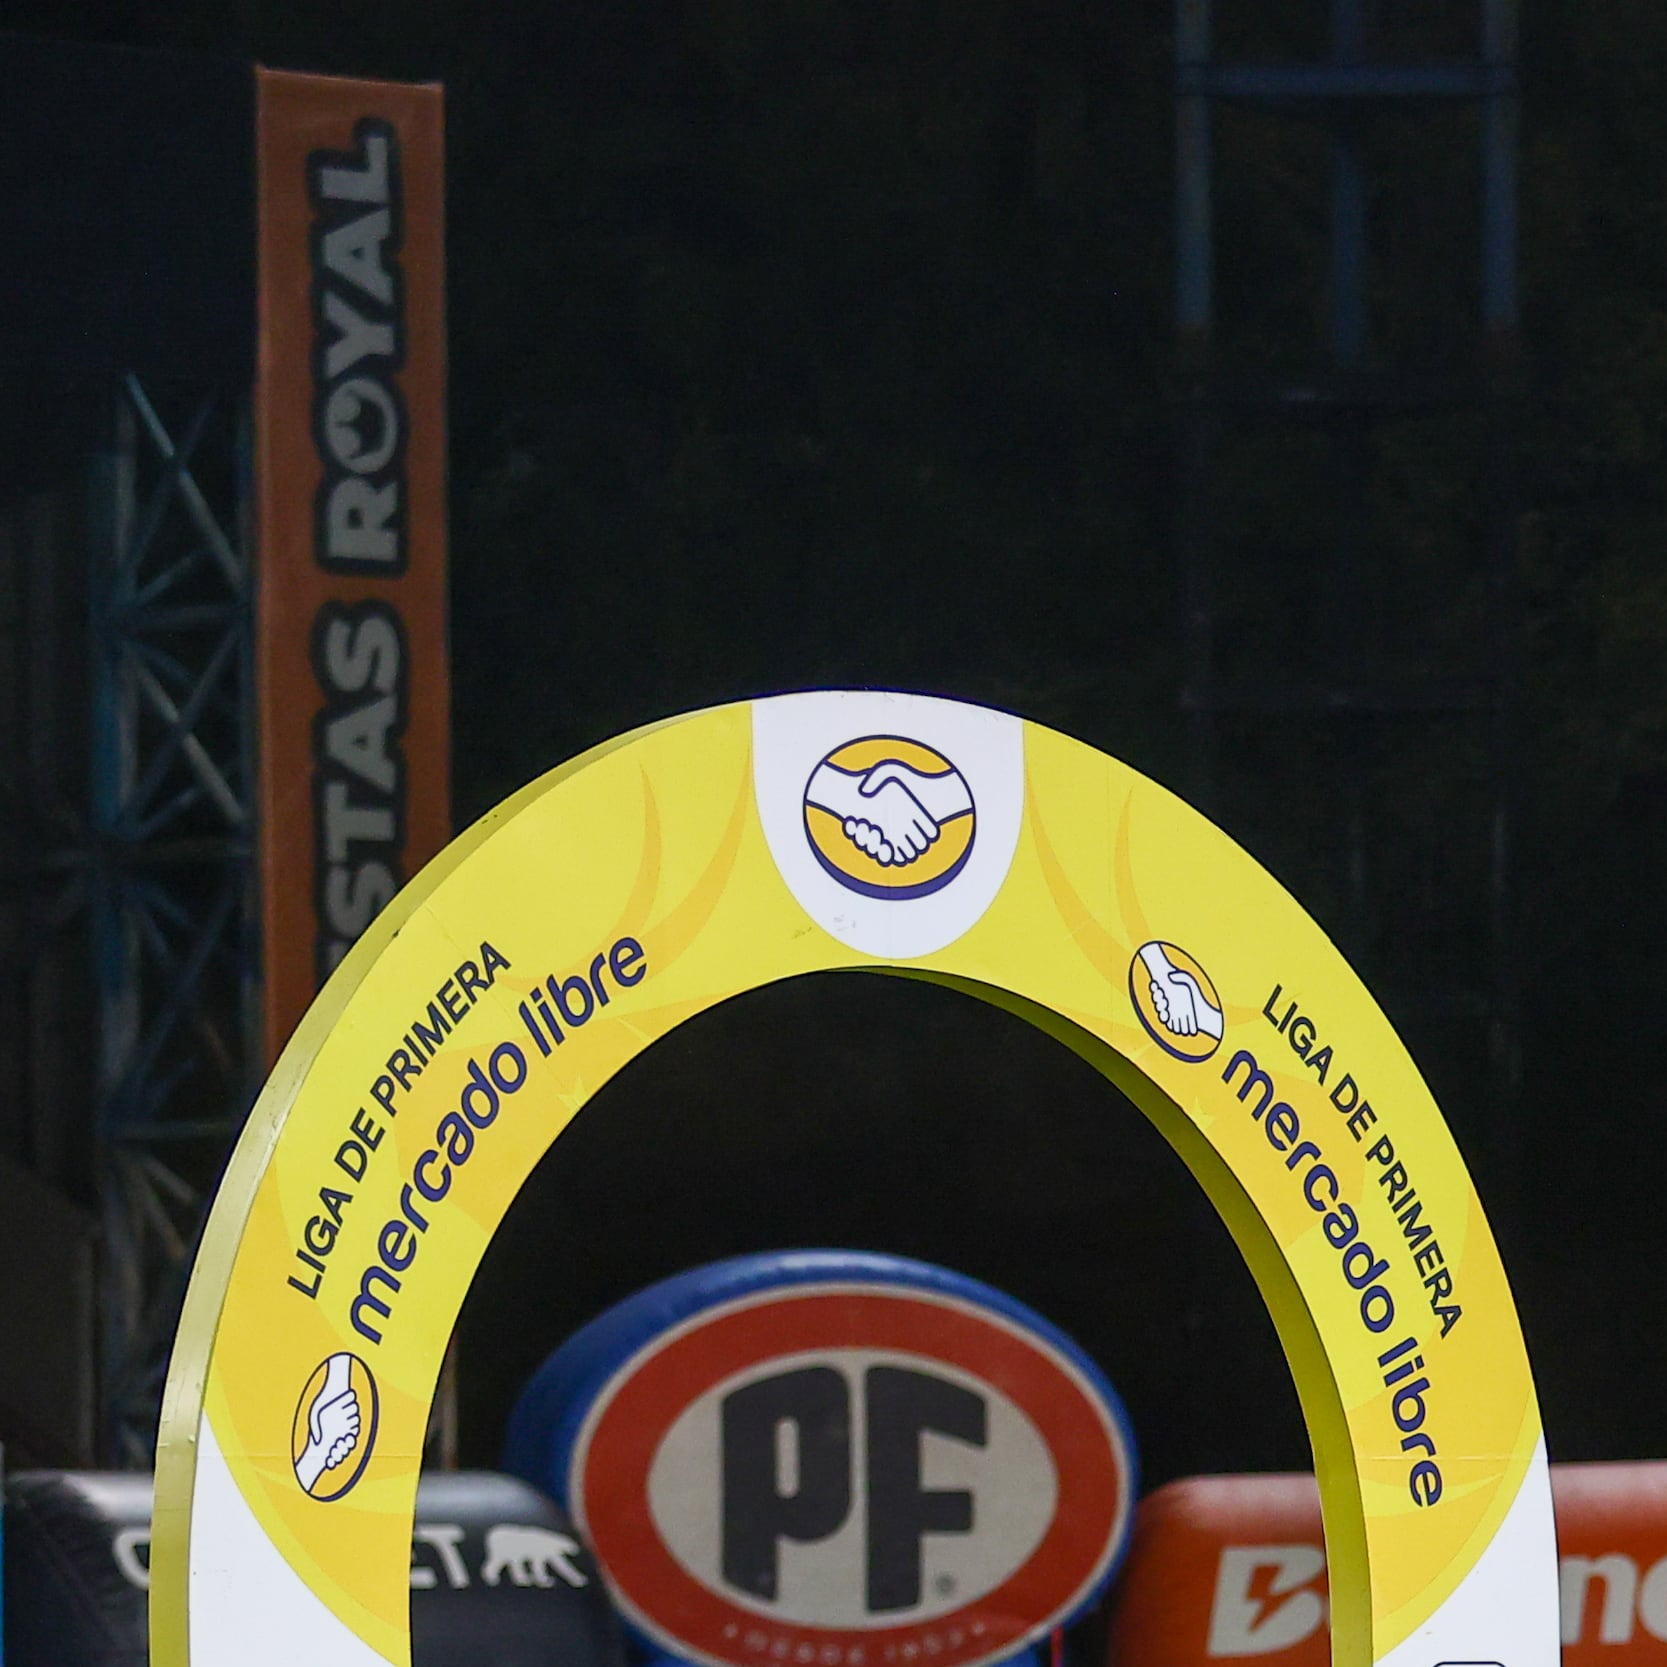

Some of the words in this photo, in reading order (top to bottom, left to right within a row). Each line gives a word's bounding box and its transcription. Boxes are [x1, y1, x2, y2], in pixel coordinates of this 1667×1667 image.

[320, 135, 399, 563] ROYAL
[325, 613, 401, 975] STAS
[286, 1185, 354, 1300] LIGA
[334, 1107, 386, 1184] DE
[369, 940, 512, 1118] PRIMERA
[349, 1041, 529, 1344] mercado
[518, 936, 648, 1059] libre
[1221, 1048, 1395, 1334] mercado
[1375, 1336, 1444, 1509] libre
[1261, 983, 1333, 1086] LIGA
[1328, 1072, 1377, 1142] DE
[1366, 1134, 1464, 1339] PRIMERA
[719, 1363, 989, 1615] PF
